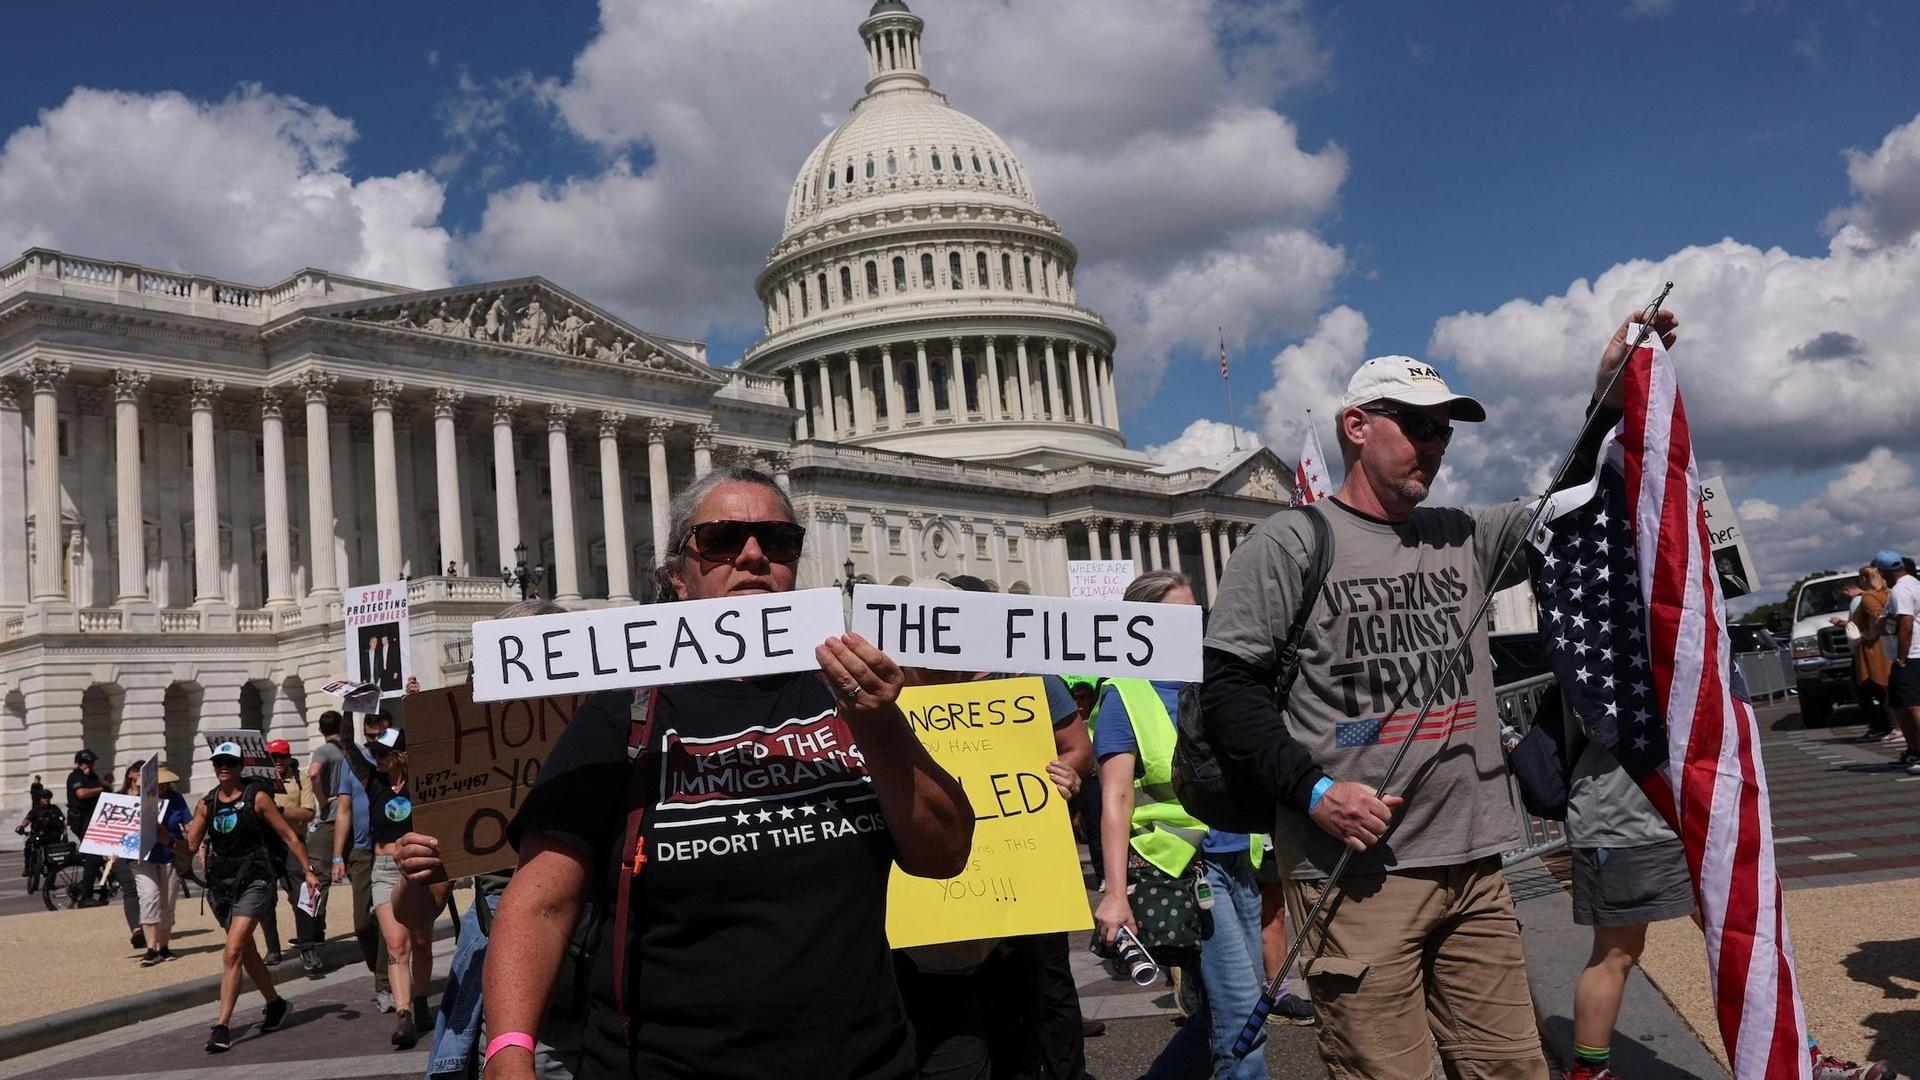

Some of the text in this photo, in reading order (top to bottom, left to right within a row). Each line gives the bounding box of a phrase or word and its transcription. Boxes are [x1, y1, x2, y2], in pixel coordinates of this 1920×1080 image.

[1069, 562, 1129, 574] WHERE ARE
[1074, 575, 1097, 586] THE
[346, 598, 407, 616] PROTECTING
[362, 588, 392, 604] STOP
[1071, 585, 1126, 597] CRIMINAL
[1322, 566, 1468, 616] VETERANS
[348, 609, 406, 626] PEDOPHILES
[866, 603, 1154, 667] THE FILES
[1345, 605, 1465, 659] AGAINST
[498, 605, 794, 684] RELEASE
[1330, 642, 1474, 718] TRUMP
[447, 690, 578, 764] HON
[909, 695, 1035, 733] NGRESS
[694, 725, 837, 773] KEEP THE
[922, 739, 994, 753] OU HAVE
[415, 769, 457, 792] 1-877-
[491, 757, 541, 809] YO
[672, 744, 866, 795] IMMIGRANTS
[657, 814, 886, 862] DEPORT THE RACIS
[1003, 838, 1037, 851] THIS
[935, 878, 1017, 902] YOU!!!
